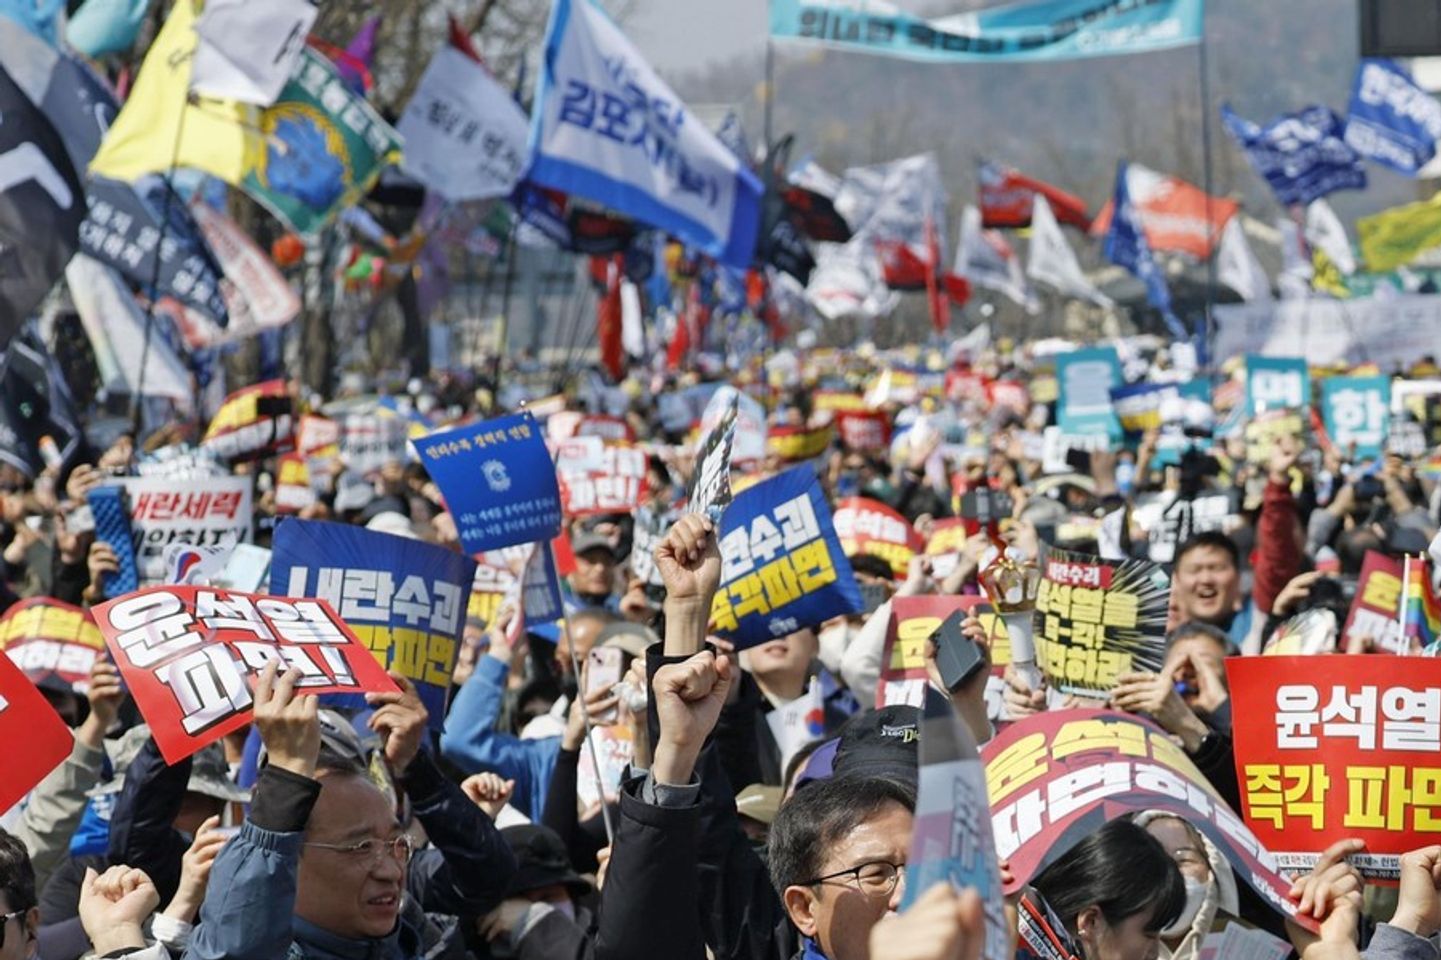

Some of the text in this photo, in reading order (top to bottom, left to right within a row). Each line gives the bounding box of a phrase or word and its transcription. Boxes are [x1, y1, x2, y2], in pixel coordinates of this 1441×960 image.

[718, 492, 821, 588] 란수괴
[108, 590, 351, 668] 윤석열
[1244, 764, 1331, 830] 즉각
